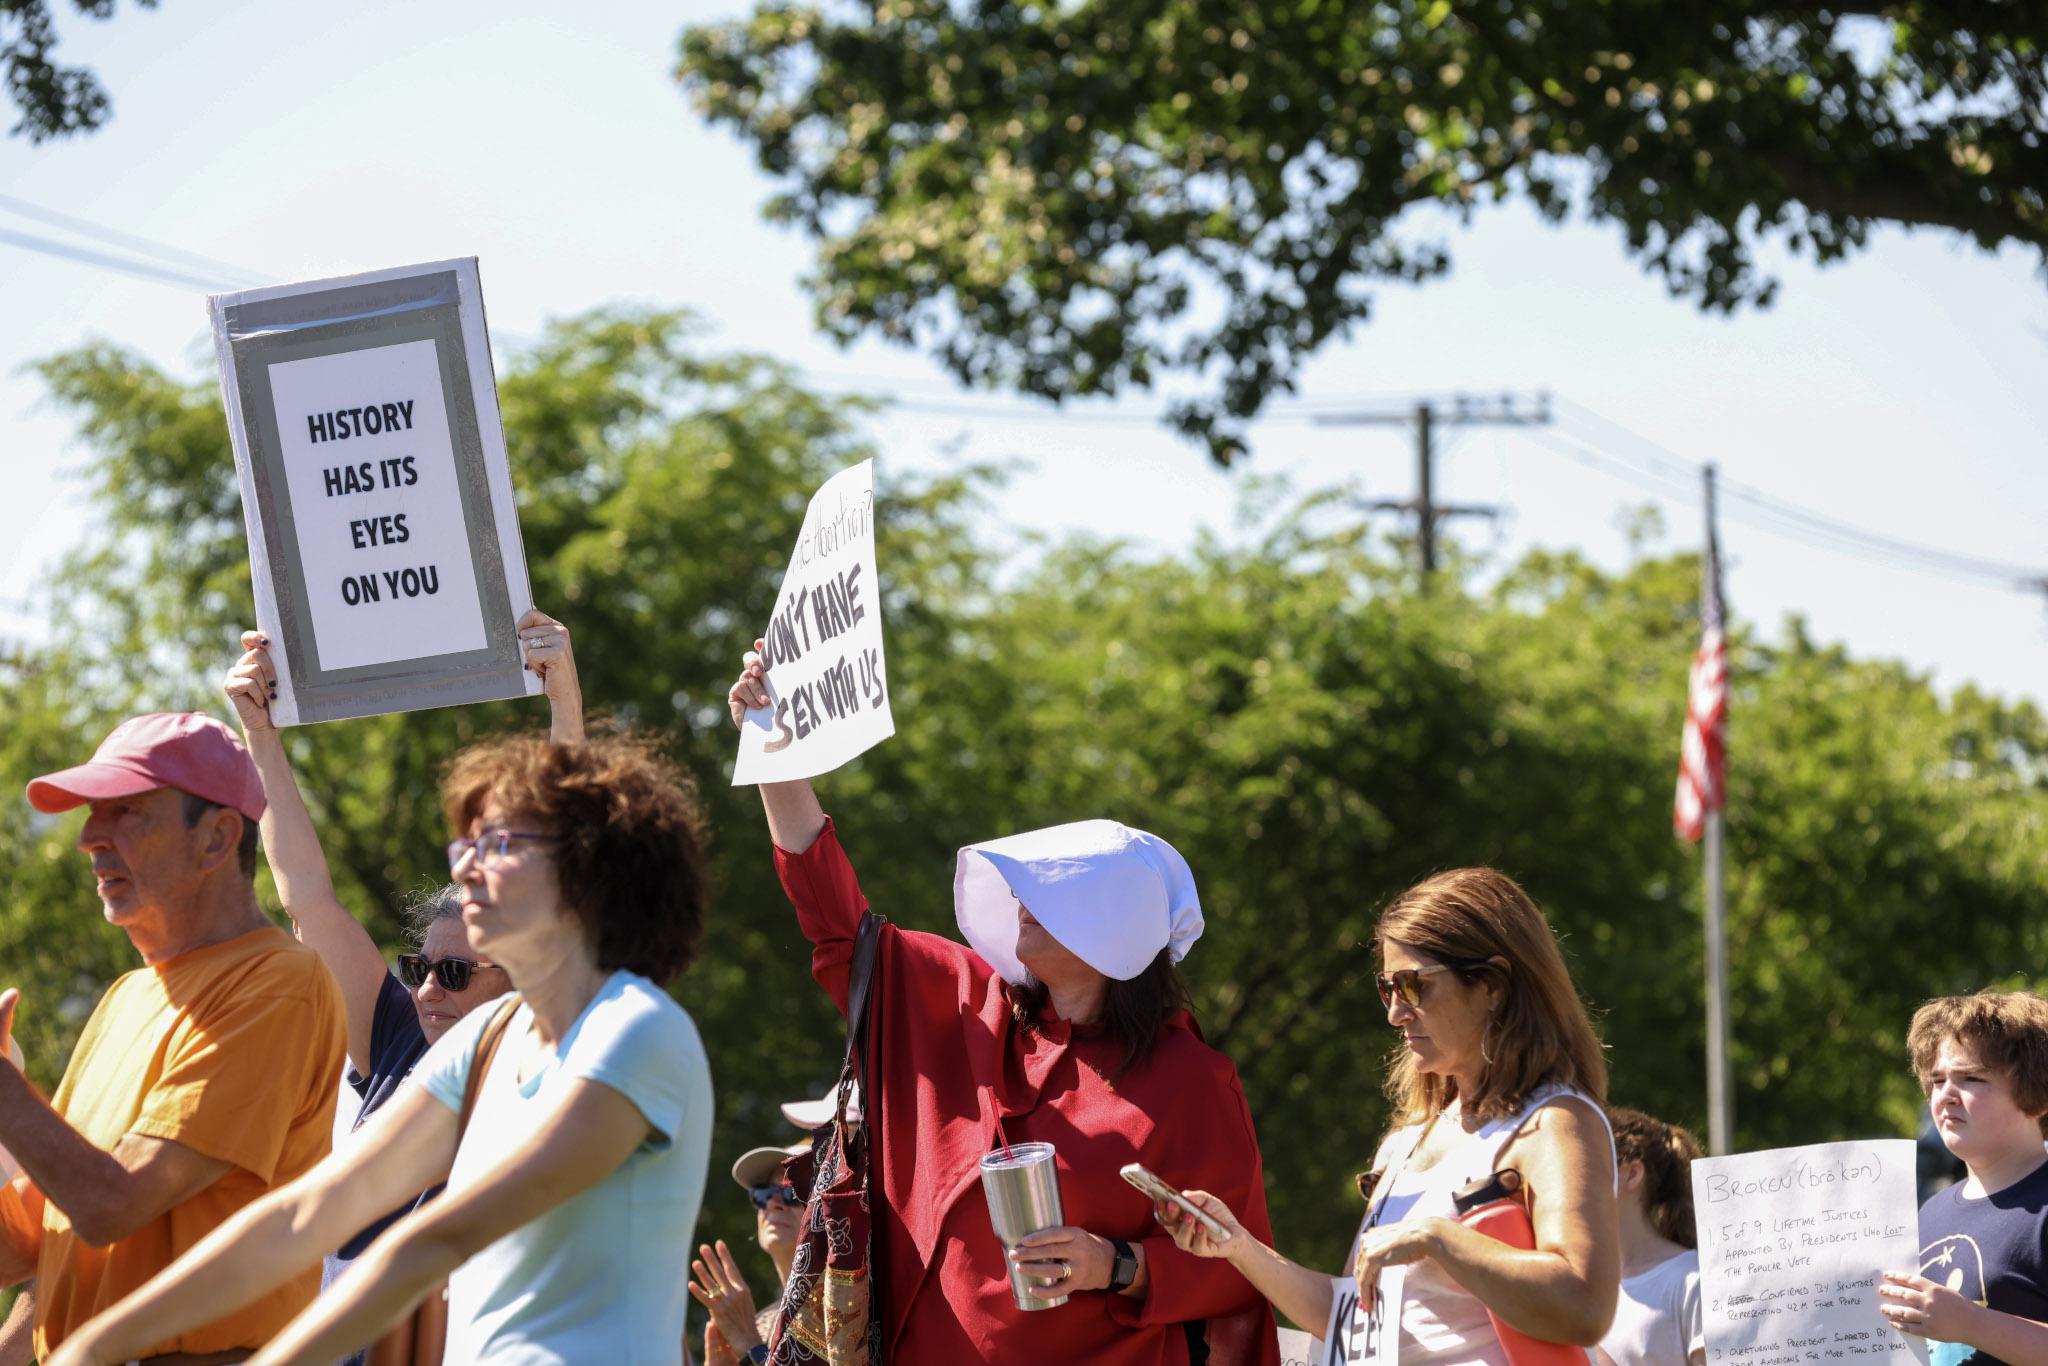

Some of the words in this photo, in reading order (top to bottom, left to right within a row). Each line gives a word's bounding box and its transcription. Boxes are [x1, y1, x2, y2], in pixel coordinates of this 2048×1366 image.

[307, 400, 414, 443] HISTORY
[323, 462, 375, 497] HAS
[380, 456, 418, 489] ITS
[350, 513, 410, 549] EYES
[341, 574, 380, 606] ON
[383, 565, 439, 600] YOU
[811, 562, 865, 644] HAVE
[763, 682, 821, 753] SEX
[816, 655, 859, 720] WITH
[859, 647, 884, 709] US
[1705, 1174, 1793, 1203] BROKEN
[1722, 1224, 1733, 1241] 5
[1734, 1221, 1747, 1239] of
[1753, 1220, 1762, 1234] 9
[1821, 1209, 1868, 1222] JUSTICES
[1725, 1245, 1773, 1261] APPOINTED
[1801, 1231, 1858, 1247] PRESIDENTS
[1723, 1266, 1742, 1278] THE
[1748, 1262, 1782, 1274] POPULAR
[1788, 1256, 1811, 1268] VOTE
[1759, 1286, 1809, 1301] CONFIRMED
[1837, 1279, 1874, 1291] SENATORS
[1787, 1337, 1828, 1348] PRECEDENT
[1834, 1332, 1870, 1342] SUPPORTED
[1824, 1349, 1844, 1359] MORE
[1848, 1346, 1868, 1355] THAN
[1872, 1344, 1885, 1353] 50
